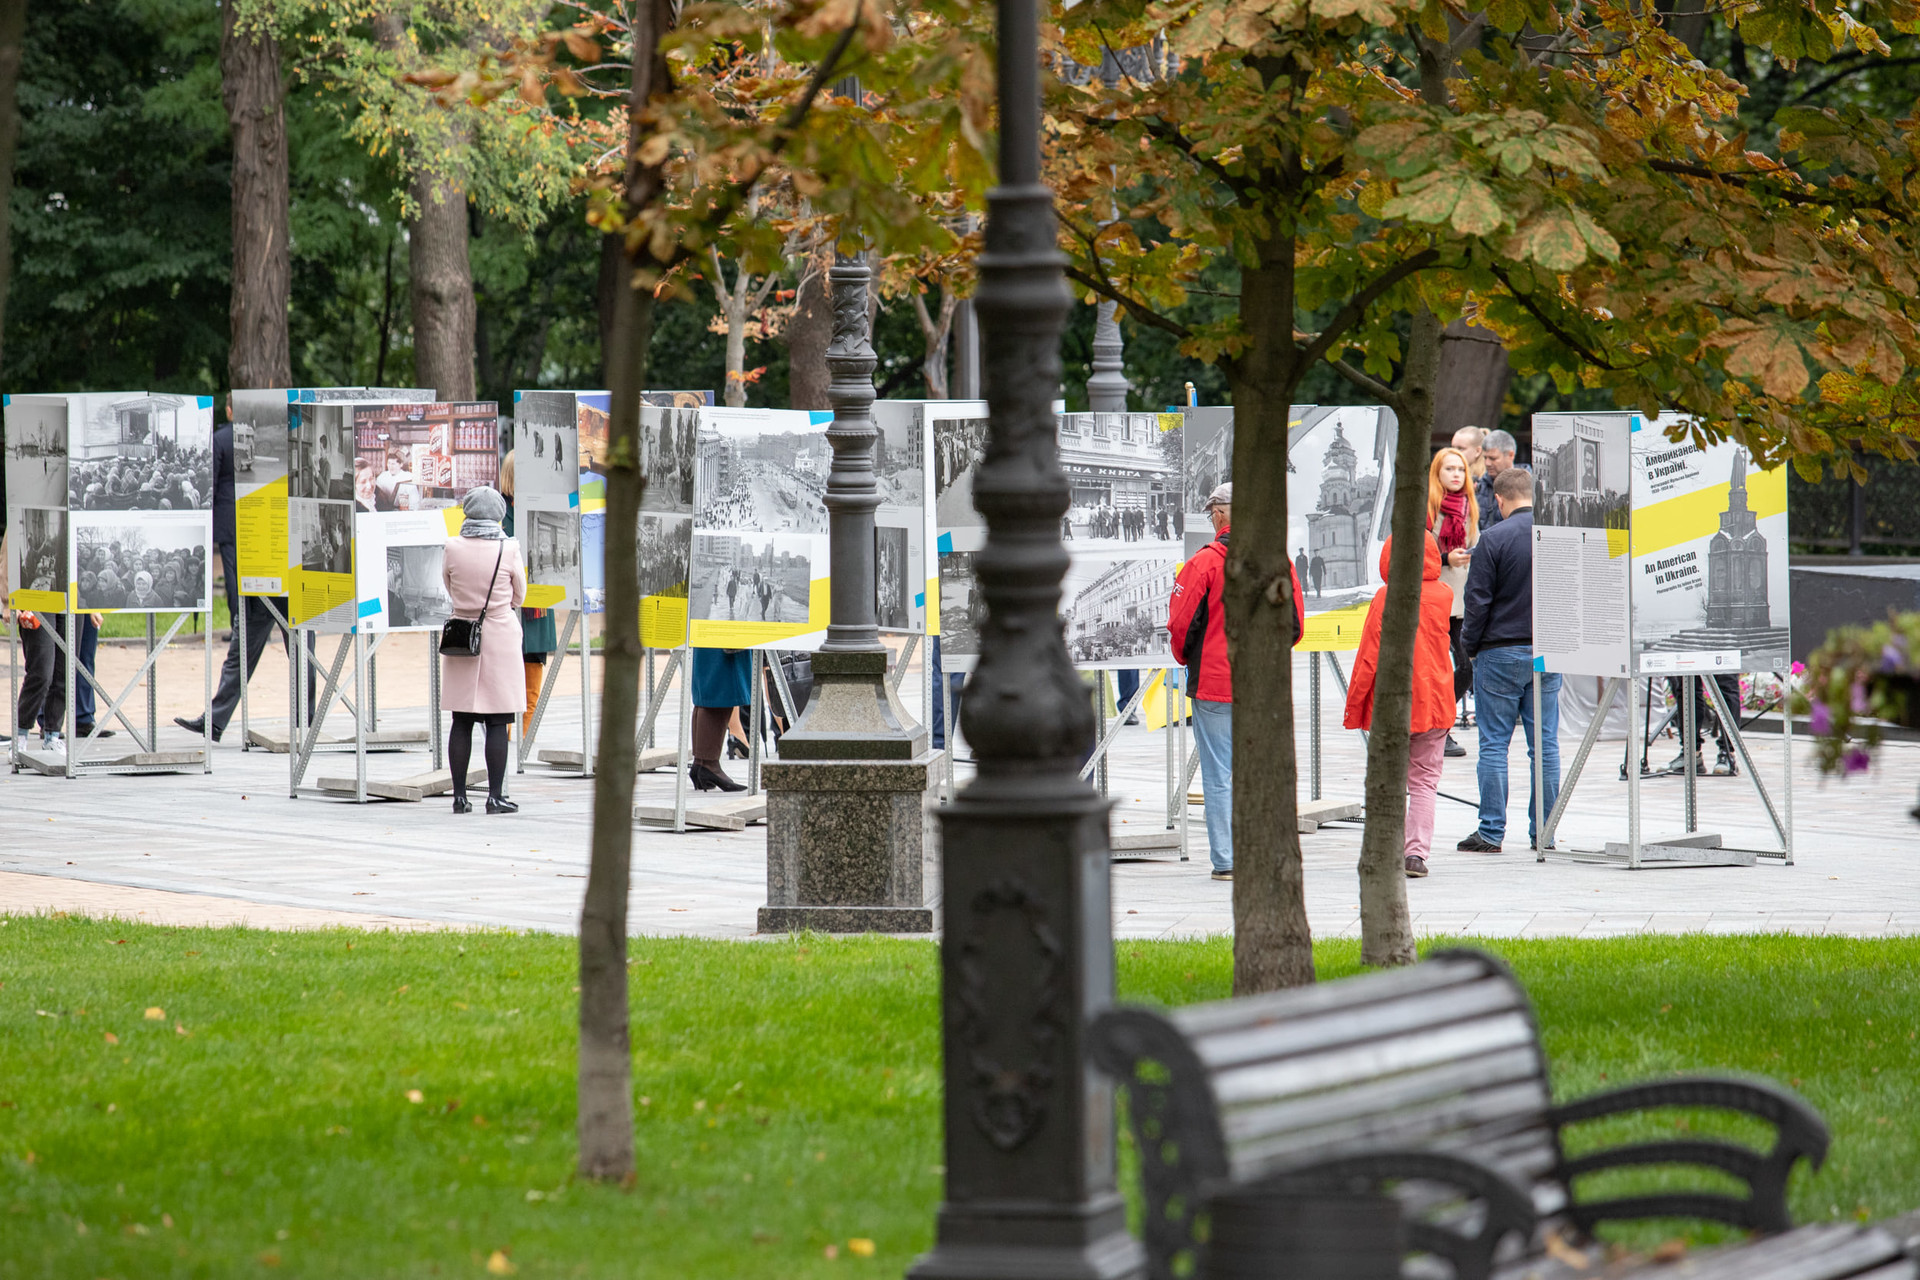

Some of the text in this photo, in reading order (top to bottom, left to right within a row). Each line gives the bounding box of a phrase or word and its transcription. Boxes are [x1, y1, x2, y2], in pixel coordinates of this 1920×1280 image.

[1645, 444, 1700, 467] Американец
[1062, 465, 1141, 477] ЯЧА КНИГА
[1648, 471, 1654, 480] в
[1654, 460, 1688, 478] Україні.
[1645, 551, 1697, 574] An American
[1655, 575, 1664, 585] in
[1664, 565, 1700, 582] Ukraine.
